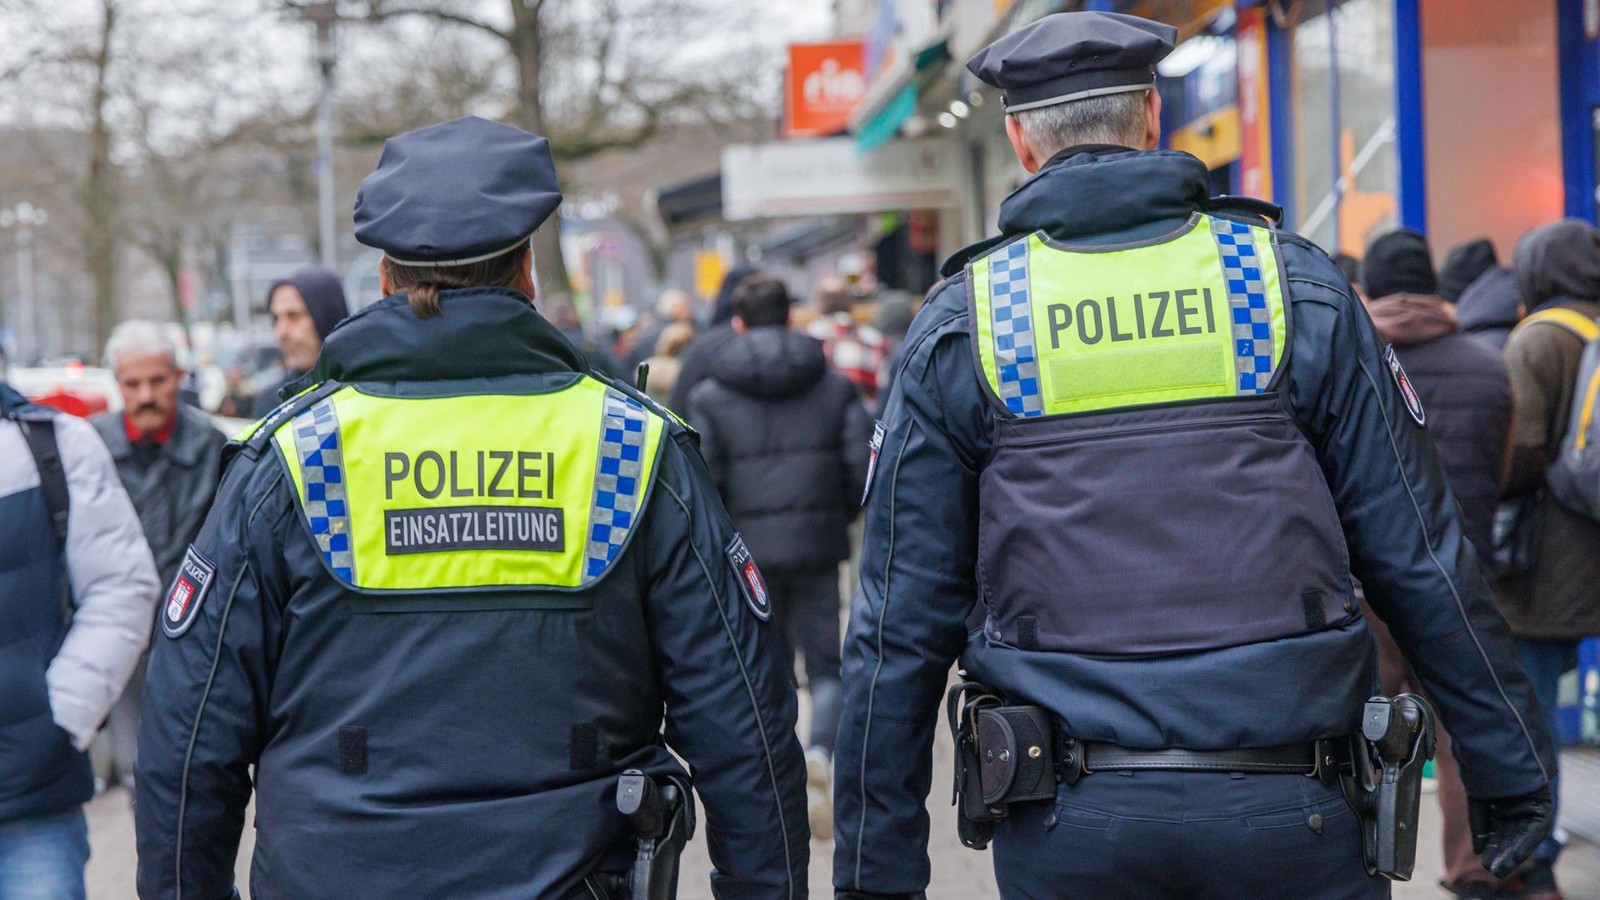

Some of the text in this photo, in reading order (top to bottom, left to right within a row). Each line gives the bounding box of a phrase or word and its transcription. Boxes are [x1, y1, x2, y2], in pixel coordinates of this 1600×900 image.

[1047, 288, 1216, 349] POLIZEI
[384, 450, 554, 500] POLIZEI
[390, 512, 558, 546] EINSATZLEITUNG
